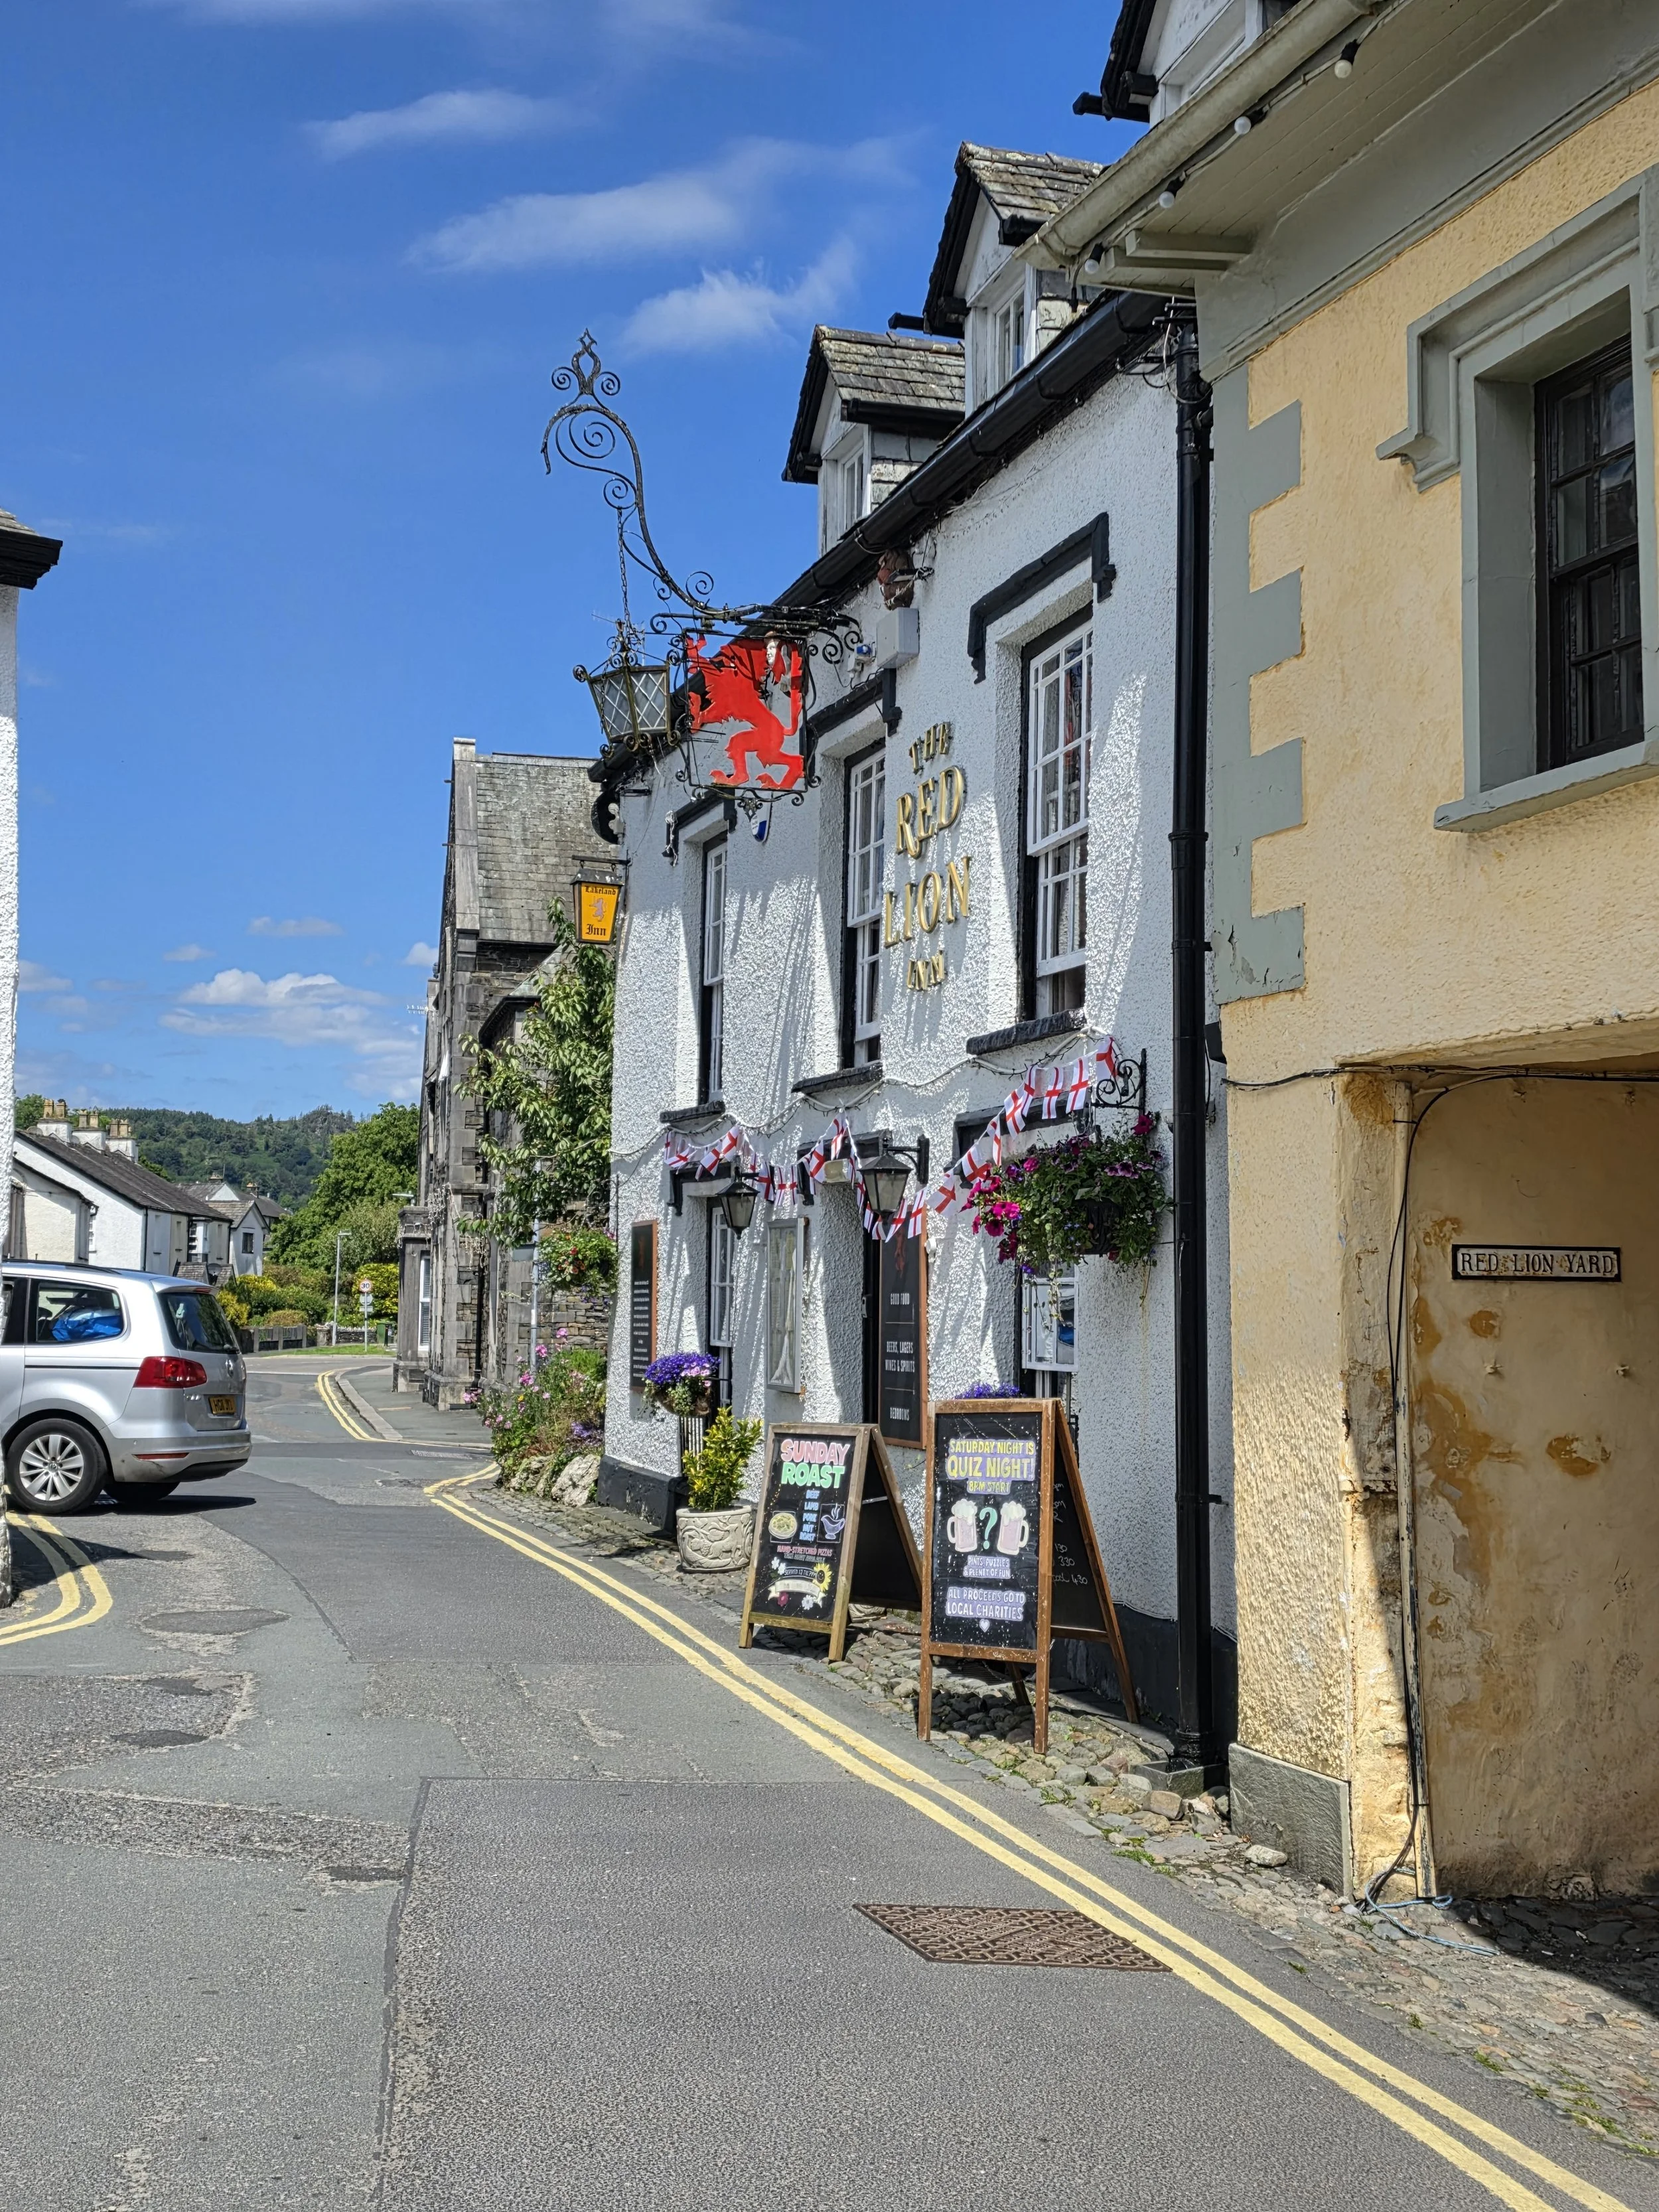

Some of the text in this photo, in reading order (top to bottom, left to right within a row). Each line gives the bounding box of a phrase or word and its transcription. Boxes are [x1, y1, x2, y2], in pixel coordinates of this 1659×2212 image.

[908, 721, 951, 775] THE
[897, 765, 964, 860] RED
[584, 885, 616, 895] Lakeland
[884, 856, 971, 949] LION
[585, 923, 607, 936] Inn
[906, 950, 945, 990] INN
[1461, 1252, 1613, 1274] RED LION YARD
[890, 1293, 909, 1305] GOOD FOOD
[900, 1341, 913, 1353] LAGERS
[885, 1359, 896, 1371] WINES
[901, 1360, 915, 1372] SPIRITS
[890, 1407, 909, 1421] BEDROOMS
[780, 1439, 851, 1465] SUNDAY
[949, 1440, 1035, 1455] SATURDAY NIGHT IS
[947, 1455, 1035, 1480] QUIZ NIGHT!
[781, 1461, 845, 1489] ROAST
[968, 1481, 1010, 1493] 8PM START
[804, 1502, 819, 1511] LAMB
[802, 1513, 818, 1522] PORK
[799, 1532, 816, 1541] ROAST
[817, 1548, 833, 1557] PIZZAS
[985, 1558, 1009, 1567] PUZZLES
[990, 1568, 998, 1577] OF
[948, 1589, 1025, 1604] ALL PROCEEDS GO TO
[947, 1601, 1023, 1619] LOCAL CHARITIES
